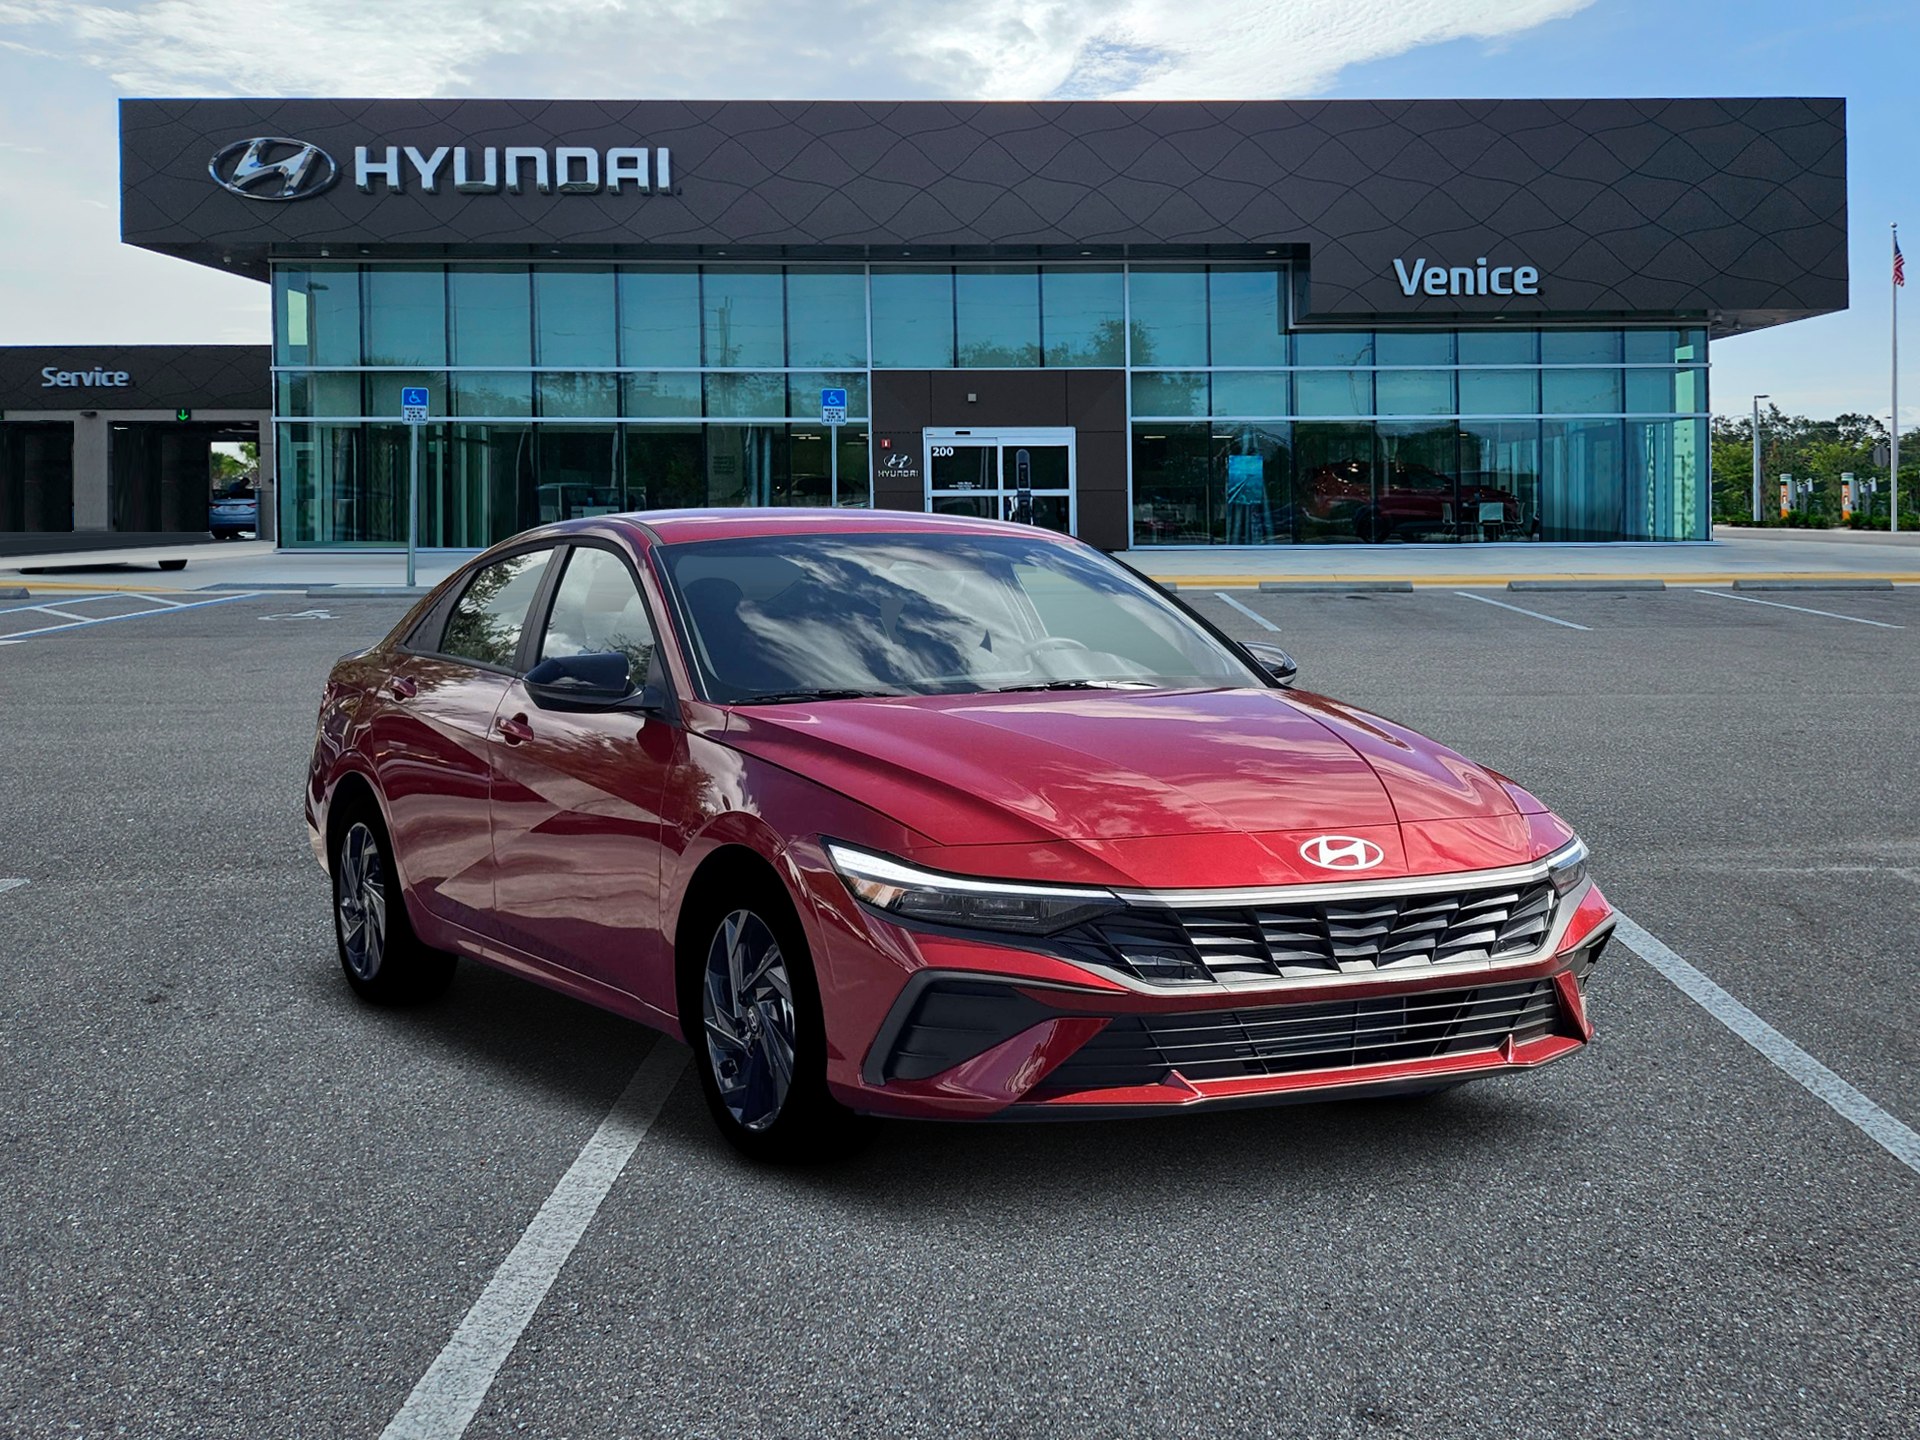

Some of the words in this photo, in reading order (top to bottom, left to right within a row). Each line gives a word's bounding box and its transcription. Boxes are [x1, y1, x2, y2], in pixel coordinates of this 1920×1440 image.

[355, 146, 669, 194] HYUNDAI
[1393, 257, 1539, 296] Venice
[41, 366, 130, 387] Service
[932, 446, 954, 457] 200
[877, 470, 919, 478] HYUNDAI
